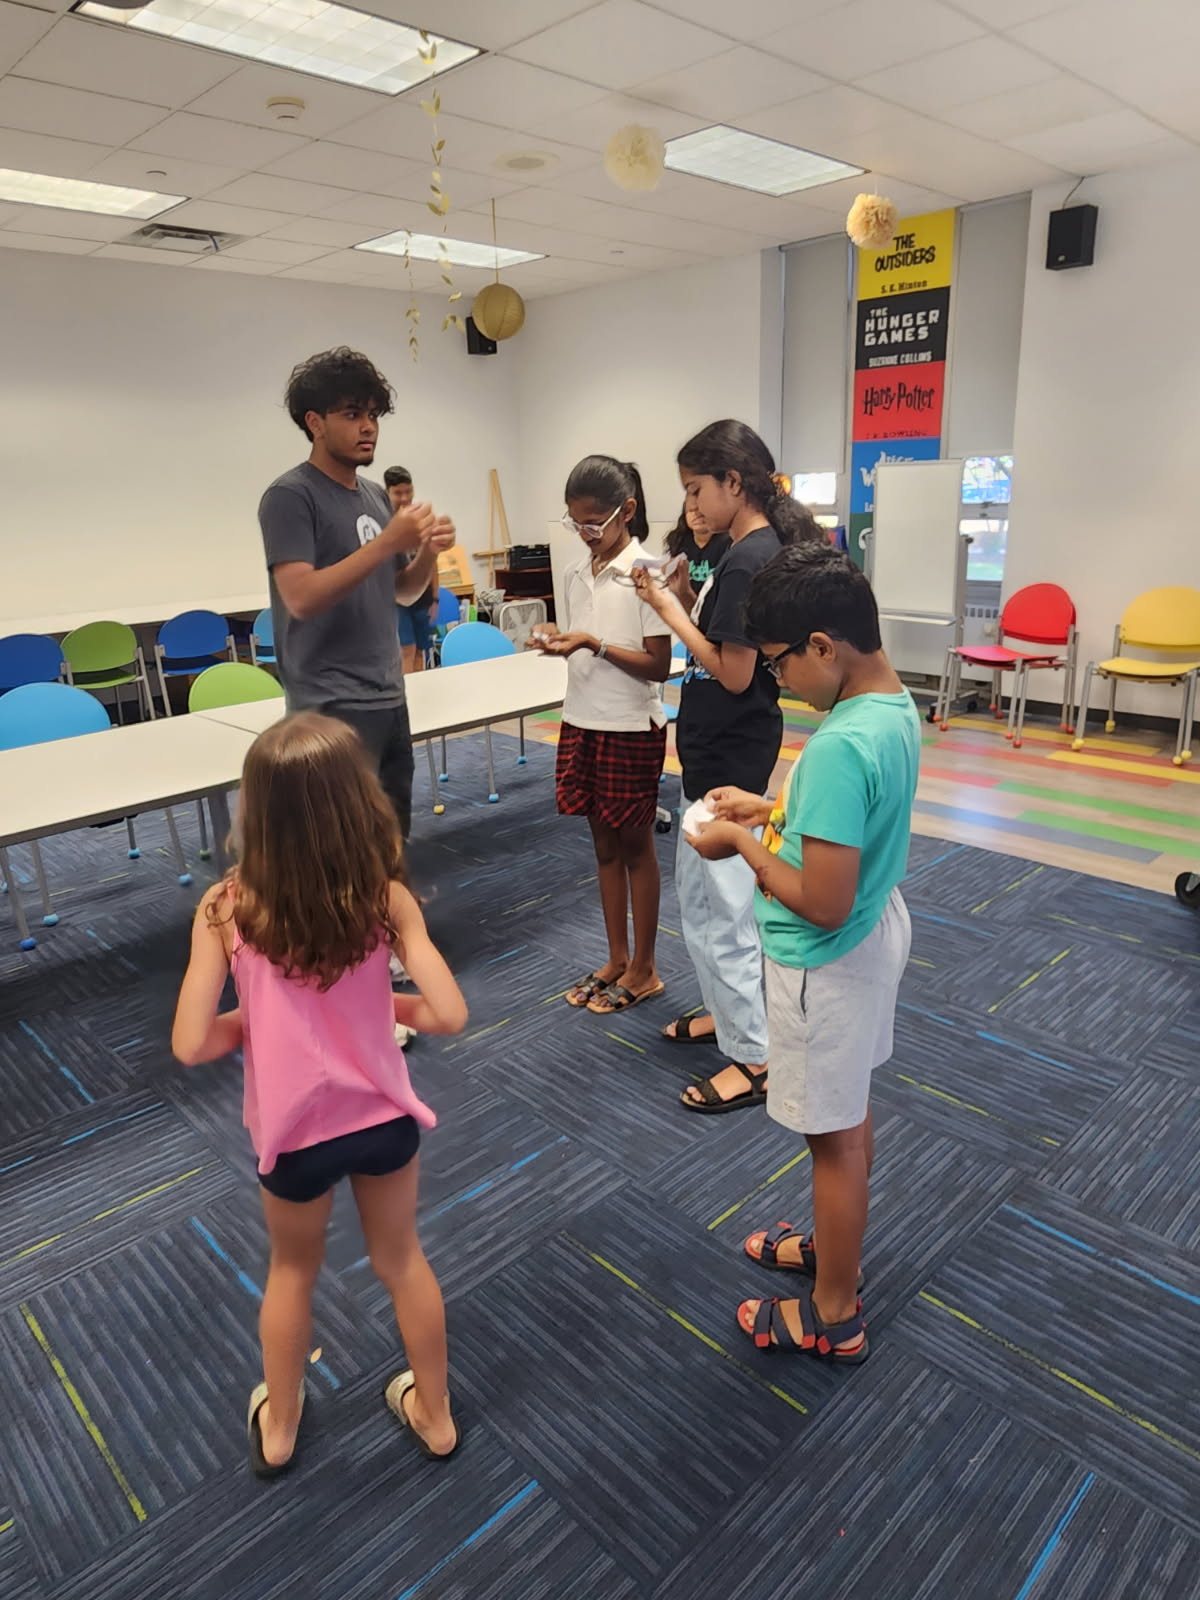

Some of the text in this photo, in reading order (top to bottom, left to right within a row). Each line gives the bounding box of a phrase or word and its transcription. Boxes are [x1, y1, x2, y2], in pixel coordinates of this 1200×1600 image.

[893, 233, 915, 251] THE
[875, 246, 936, 272] OUTSIDERS
[865, 310, 940, 332] HUNGER
[870, 307, 888, 317] THE
[864, 326, 929, 346] GAMES
[864, 382, 935, 416] Harry Potter
